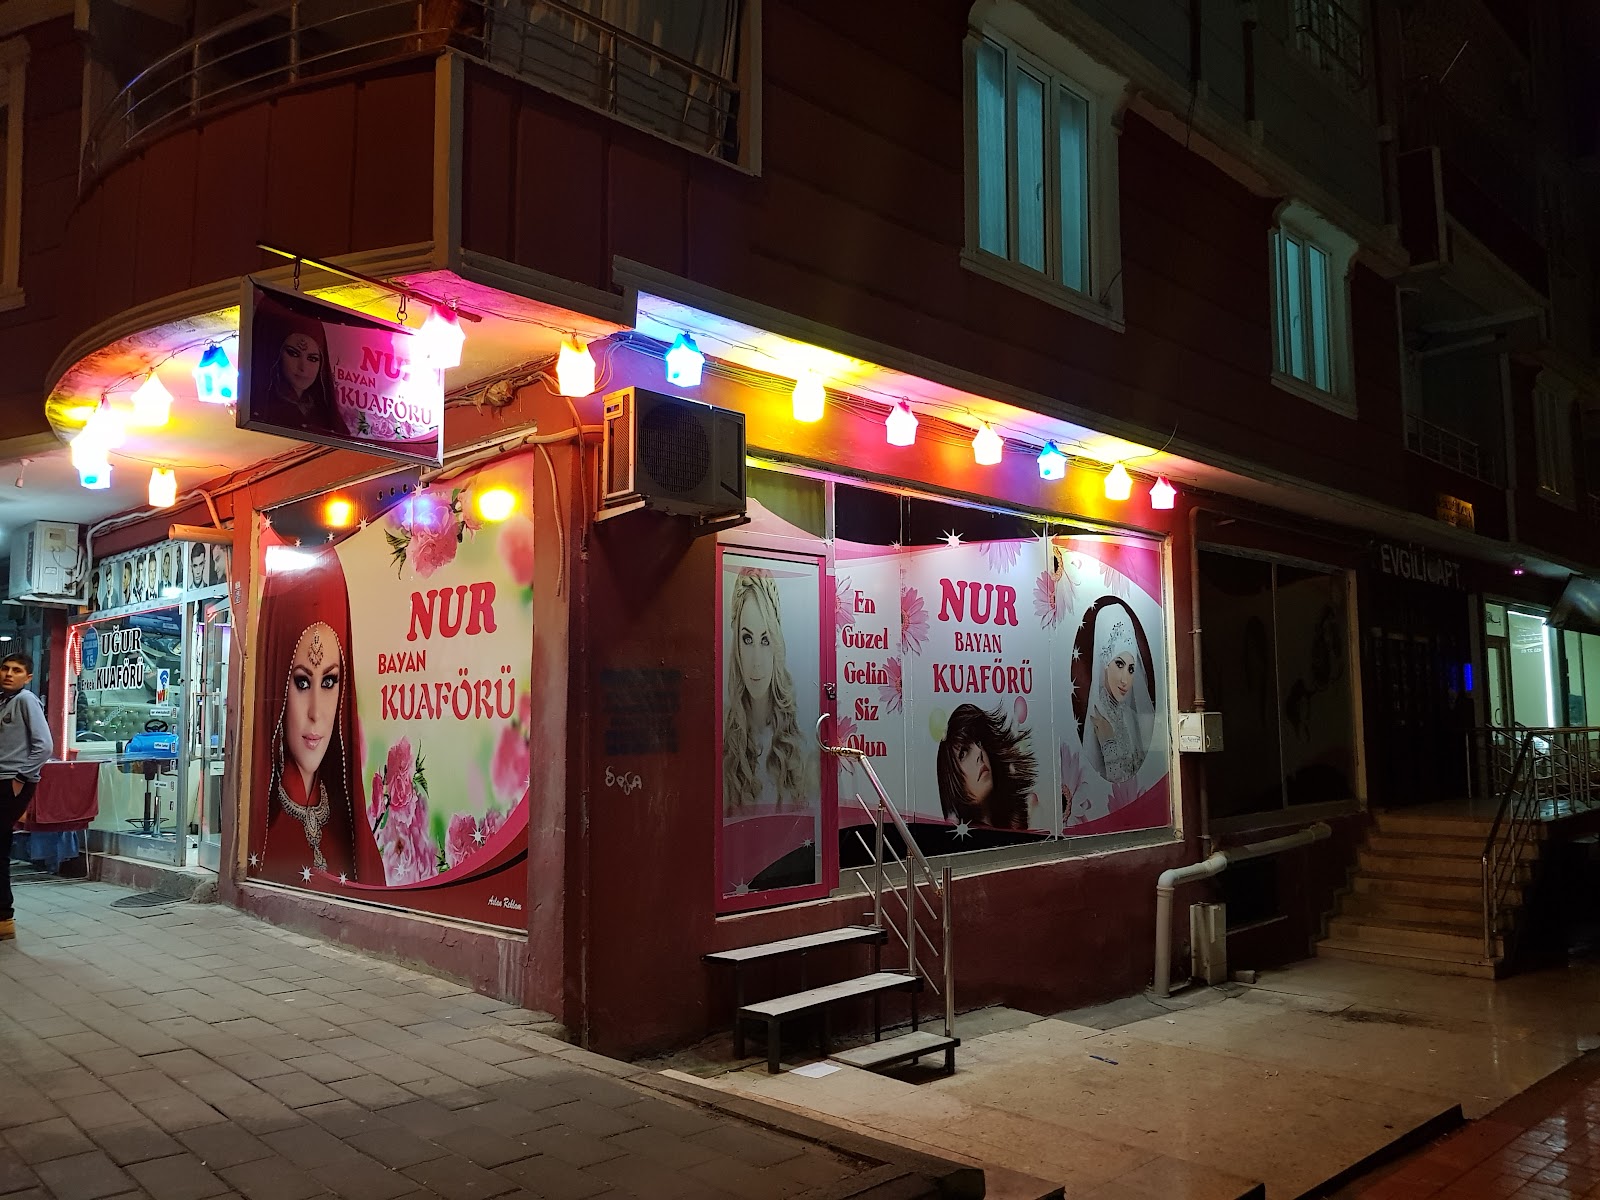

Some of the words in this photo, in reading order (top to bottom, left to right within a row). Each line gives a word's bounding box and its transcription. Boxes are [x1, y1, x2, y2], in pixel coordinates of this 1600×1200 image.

[337, 368, 376, 388] BAYAN
[406, 581, 497, 641] NUR
[854, 590, 876, 614] En
[937, 578, 1019, 627] NUR
[101, 626, 141, 656] UĞUR
[842, 625, 888, 650] Güzel
[955, 631, 1002, 653] BAYAN
[96, 656, 144, 690] KUAFÖRÜ
[378, 650, 426, 674] BAYAN
[844, 661, 888, 685] Gelin
[932, 658, 1033, 694] KUAFÖRÜ
[380, 665, 516, 720] KUAFÖRÜ
[854, 698, 879, 721] Siz
[847, 734, 887, 757] Olun
